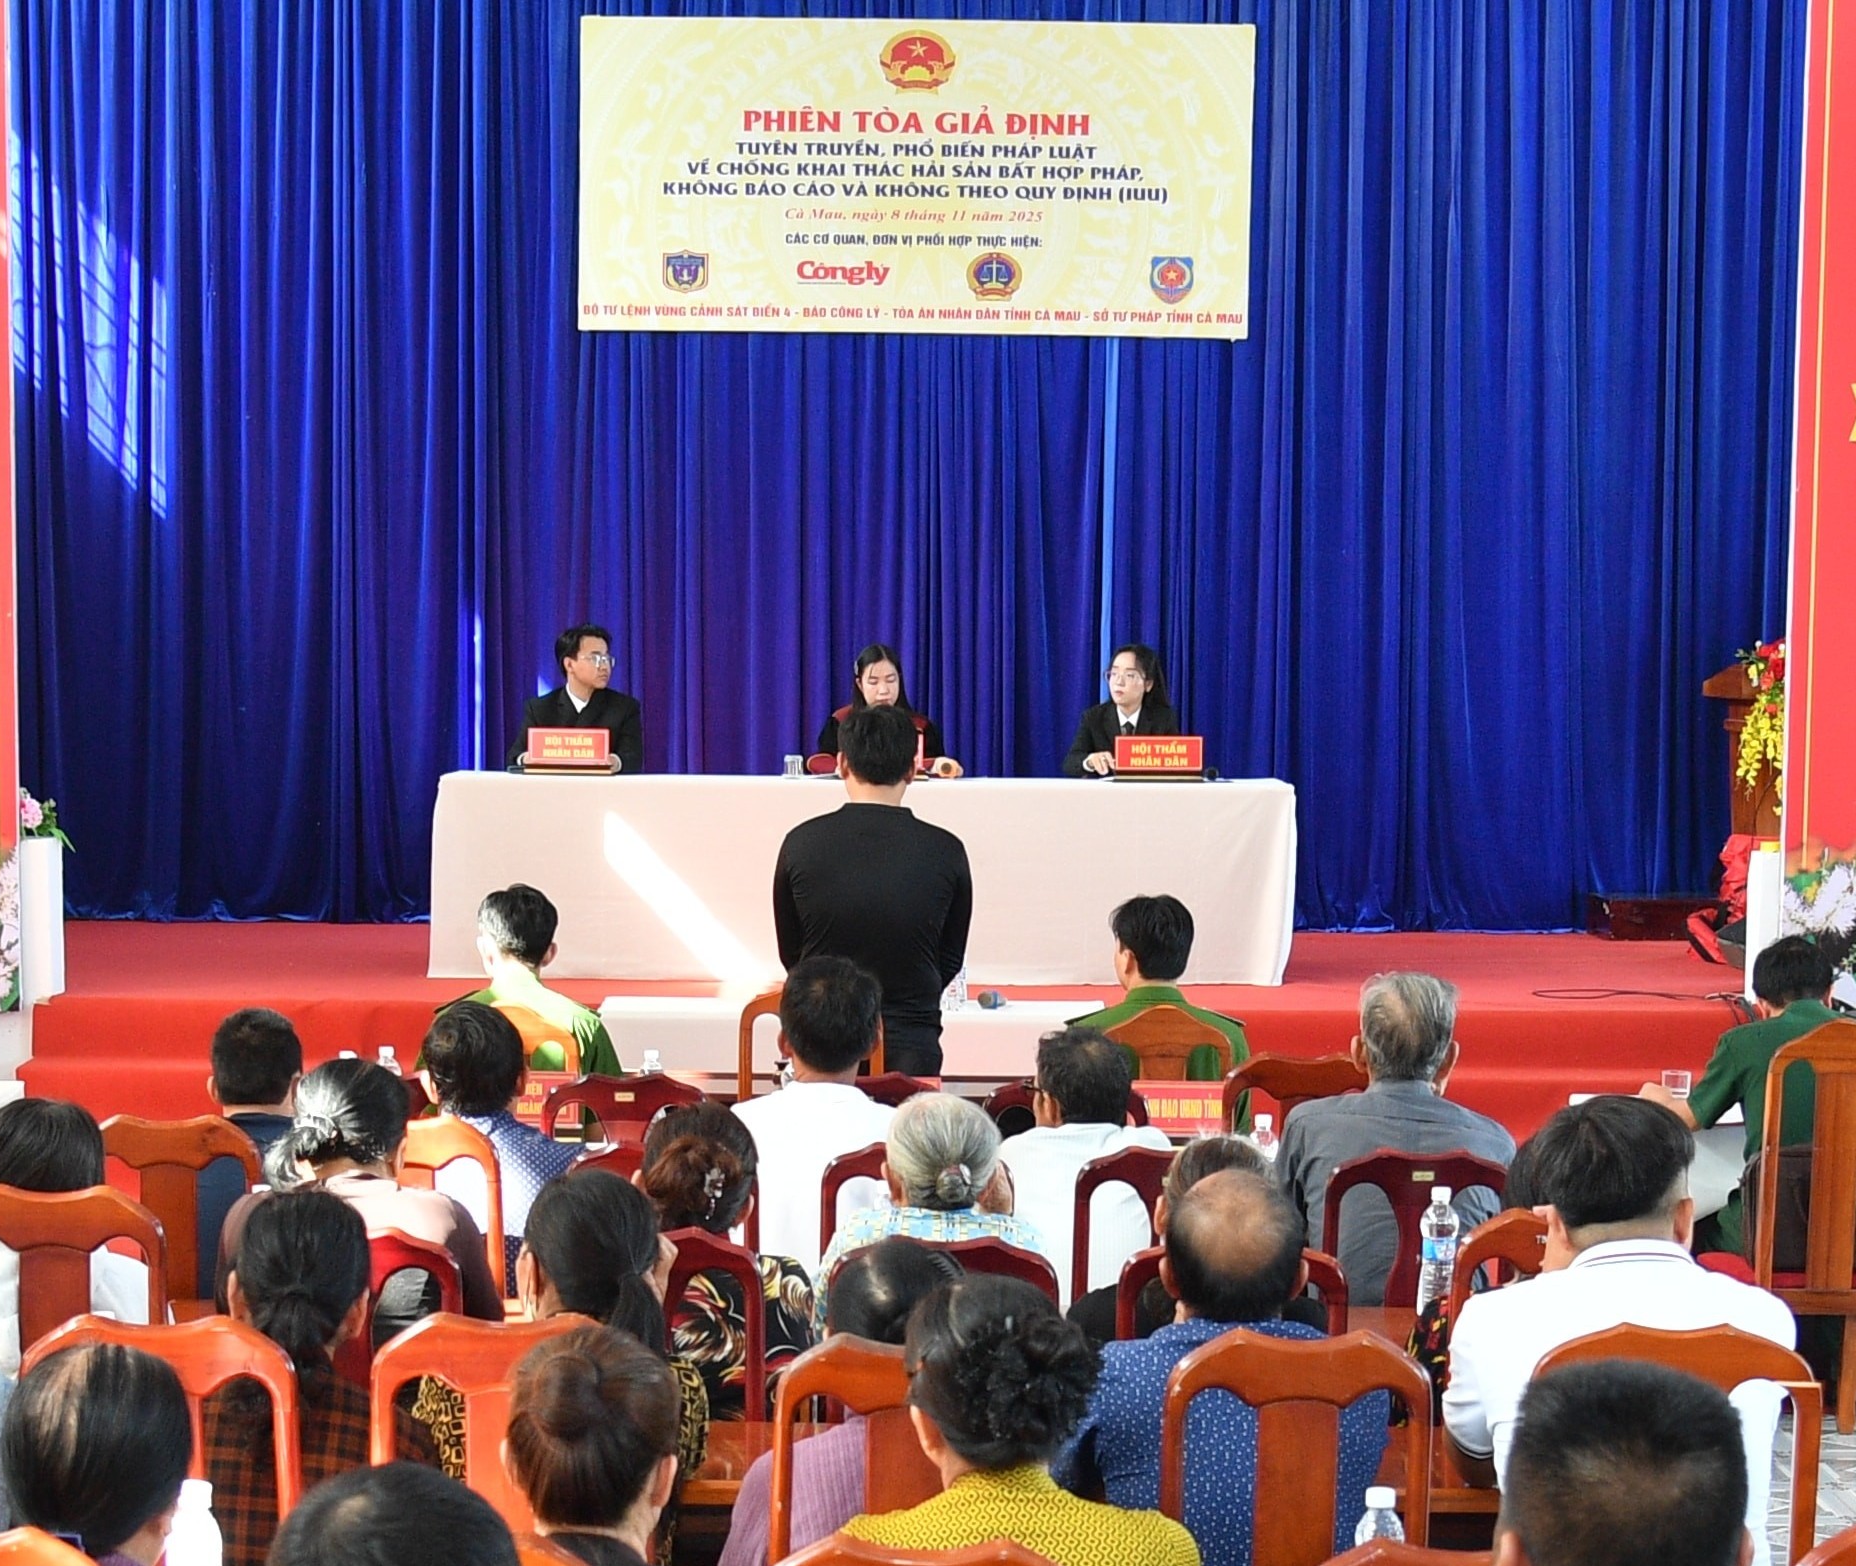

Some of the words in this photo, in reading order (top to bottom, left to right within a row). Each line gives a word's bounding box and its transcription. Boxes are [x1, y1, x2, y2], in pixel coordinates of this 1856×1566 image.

[743, 105, 841, 132] PHIÊN
[852, 106, 924, 134] TÒA
[934, 105, 995, 135] GIẢ
[1005, 112, 1090, 140] ĐỊNH
[736, 139, 797, 155] TUYÊN
[804, 138, 886, 158] TRUYỀN,
[893, 138, 934, 157] PHỔ
[941, 140, 985, 157] BIẾN
[992, 141, 1043, 158] PHÁP
[1049, 143, 1097, 162] LUẬT
[687, 157, 711, 175] VỀ
[716, 157, 790, 176] CHỐNG
[797, 162, 845, 177] KHAI
[852, 160, 905, 177] THÁC
[911, 160, 945, 178] HẢI
[952, 160, 992, 178] SẢN
[998, 161, 1036, 179] BẤT
[1043, 165, 1085, 181] HỢP
[1090, 164, 1145, 182] PHÁP,
[663, 178, 739, 196] KHÔNG
[744, 178, 787, 197] BÁO
[793, 179, 836, 197] CÁO
[842, 179, 868, 197] VÀ
[874, 180, 950, 199] KHÔNG
[956, 184, 1009, 199] THEO
[1014, 185, 1057, 201] QUY
[1062, 186, 1112, 203] ĐỊNH
[1118, 186, 1169, 204] (IUU)
[785, 207, 805, 220] Cà
[809, 209, 847, 221] Mau,
[851, 208, 887, 223] ngày
[891, 209, 901, 221] 8
[904, 208, 946, 224] tháng
[952, 209, 967, 222] 11
[971, 209, 1004, 222] năm
[1008, 210, 1043, 223] 2025
[785, 231, 810, 246] CÁC
[813, 232, 830, 246] CƠ
[833, 234, 869, 247] QUAN,
[872, 233, 898, 246] ĐƠN
[901, 234, 913, 248] VỊ
[916, 231, 945, 246] PHỐI
[948, 234, 972, 248] HỢP
[976, 234, 1007, 249] THỰC
[1010, 234, 1043, 249] HIỆN:
[583, 303, 599, 317] BỘ
[603, 304, 618, 316] TƯ
[620, 303, 651, 317] LỆNH
[655, 303, 687, 317] VÙNG
[690, 302, 723, 317] CẢNH
[726, 302, 748, 317] SÁT
[752, 302, 781, 318] BIỂN
[784, 307, 791, 317] 4
[803, 304, 827, 318] BÁO
[830, 304, 863, 318] CÔNG
[866, 305, 881, 318] LÝ
[892, 304, 915, 319] TÒA
[939, 306, 972, 320] NHÂN
[975, 306, 1001, 320] DÂN
[1004, 306, 1032, 321] TỈNH
[1034, 307, 1051, 322] CÀ
[1054, 311, 1081, 322] MAU
[1093, 307, 1110, 323] SỞ
[1112, 310, 1129, 323] TƯ
[1130, 309, 1163, 324] PHÁP
[1165, 308, 1194, 324] TỈNH
[1196, 310, 1213, 324] CÀ
[1216, 313, 1243, 325] MAU
